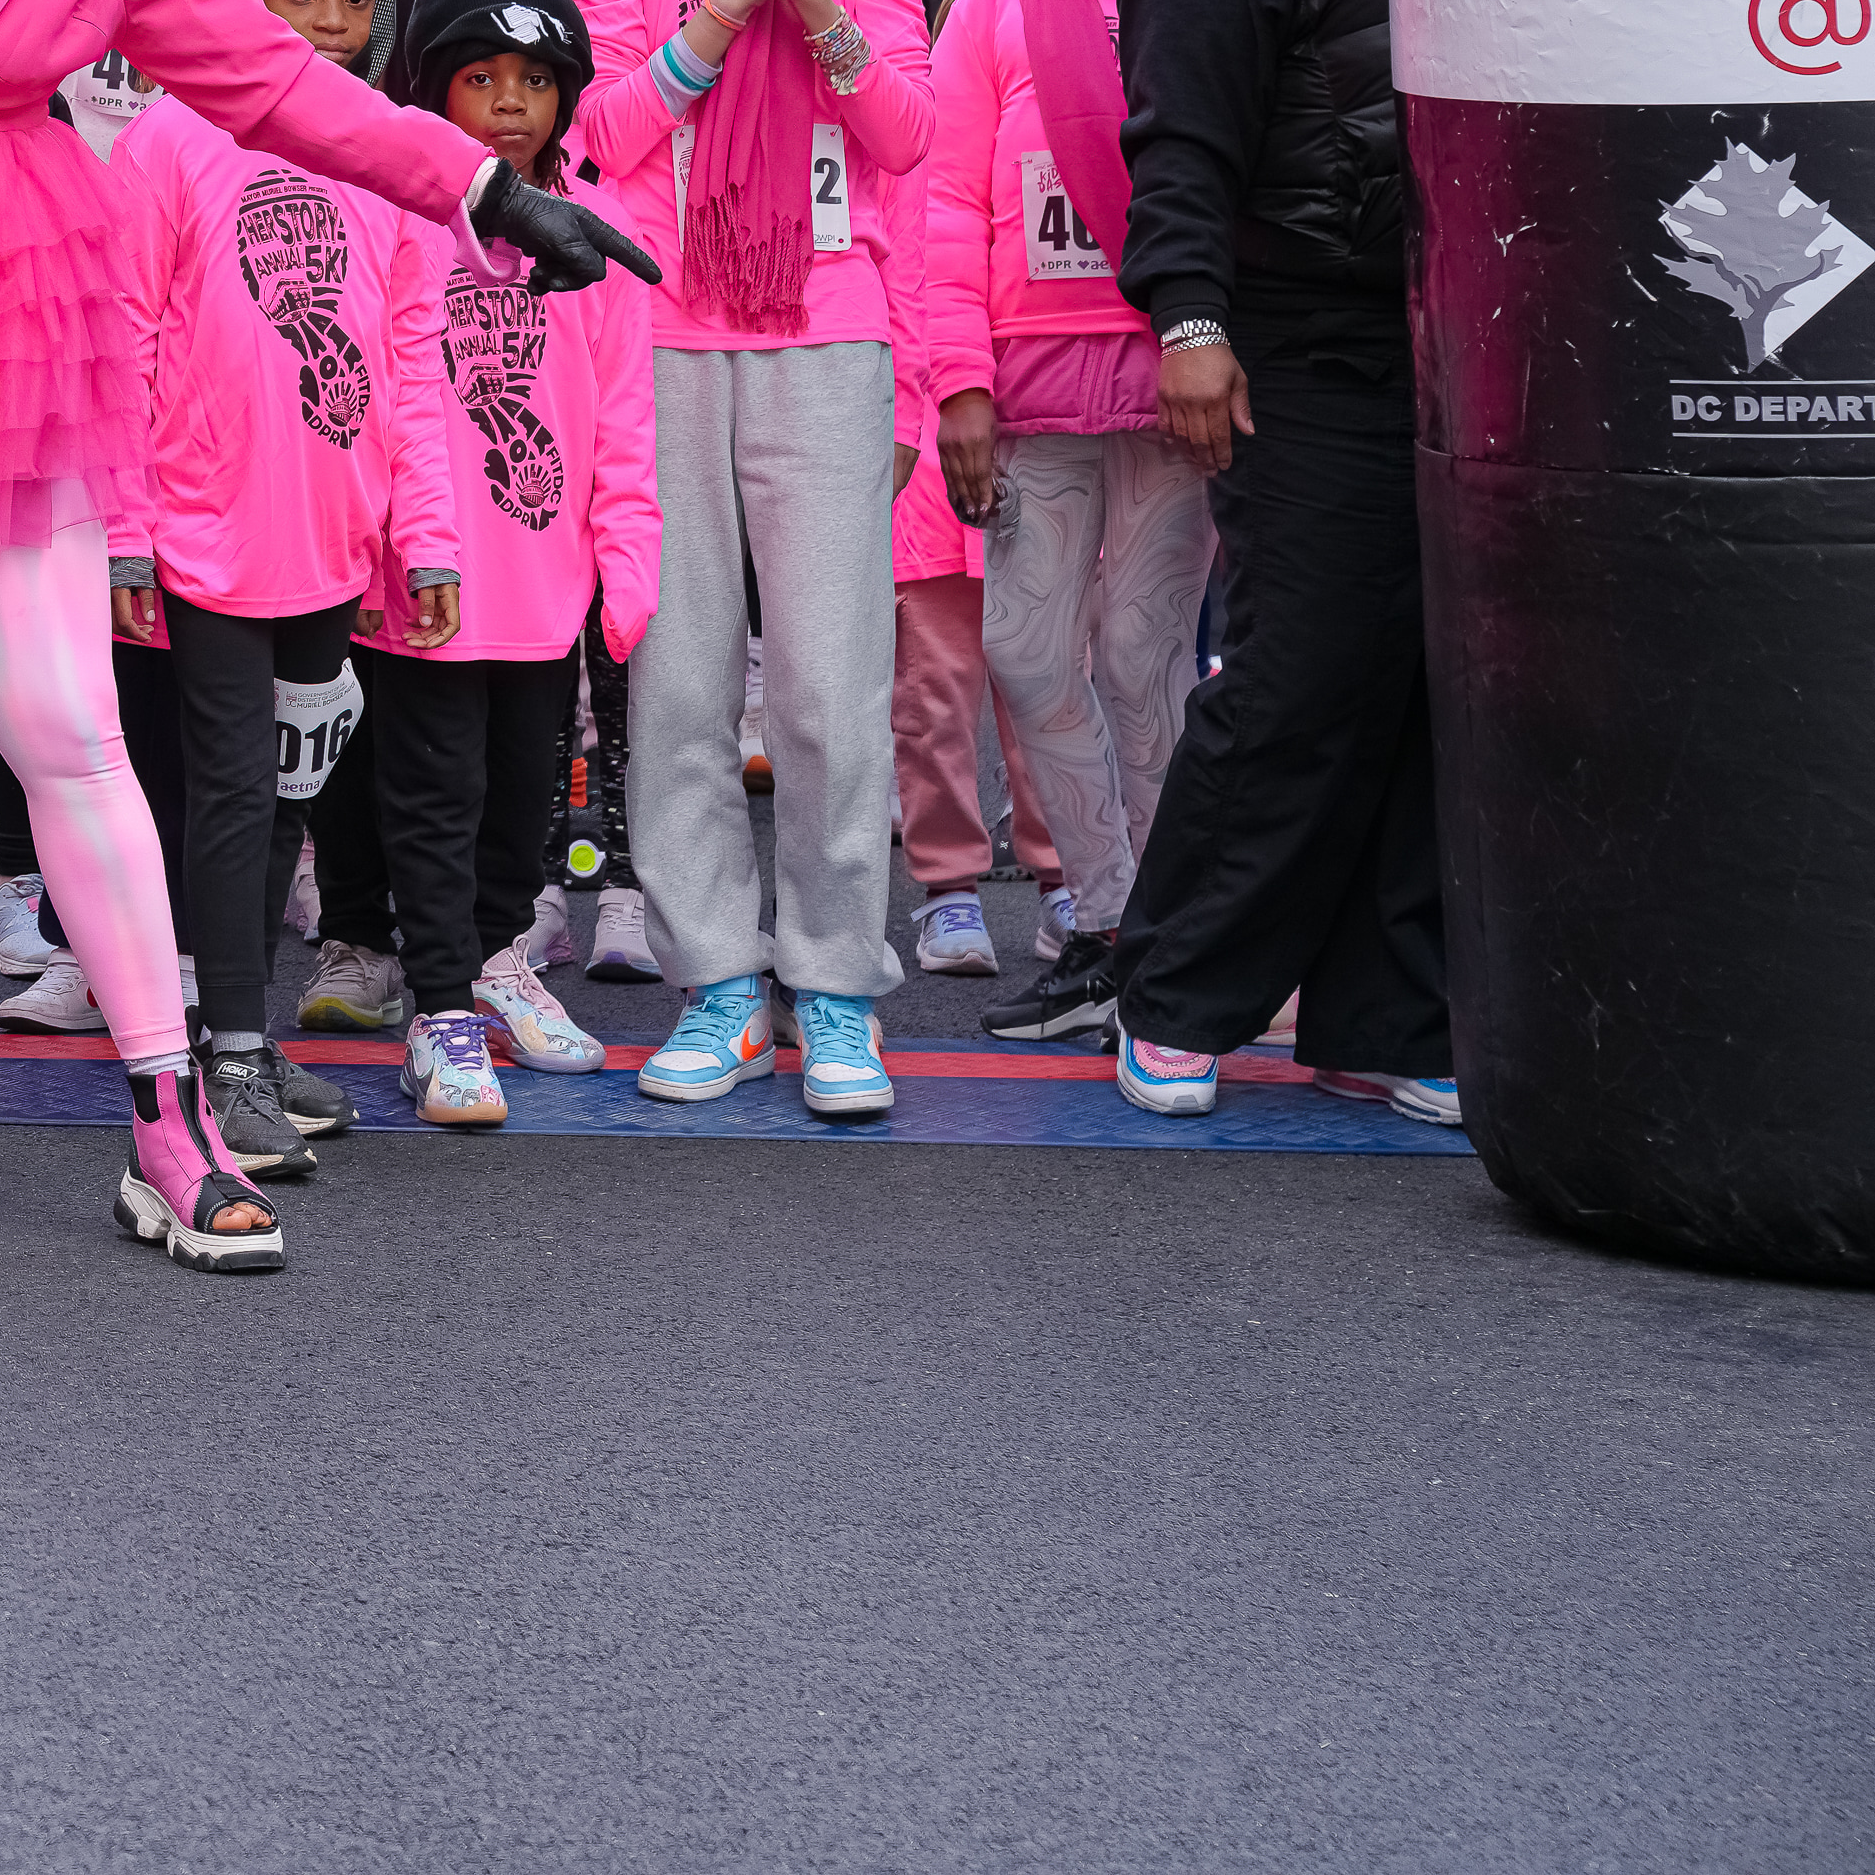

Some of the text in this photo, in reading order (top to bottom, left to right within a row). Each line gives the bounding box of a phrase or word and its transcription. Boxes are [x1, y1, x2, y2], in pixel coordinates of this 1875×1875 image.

[98, 97, 123, 108] DPR
[240, 192, 260, 203] MAYOR
[261, 188, 282, 198] MURIEL
[283, 185, 307, 193] BOWSER
[242, 201, 338, 247] HERSTORY
[254, 245, 341, 283] ANNUAL 5K
[1048, 260, 1071, 270] DPR
[445, 277, 464, 286] MAYOR
[445, 288, 540, 332] HERSTORY
[454, 331, 539, 369] ANNUAL 5K
[354, 364, 370, 423] FITDC
[1671, 395, 1722, 421] DC
[307, 415, 340, 444] DPR
[546, 446, 564, 505] FITDC
[499, 496, 529, 526] DPR
[280, 779, 320, 793] aetna
[221, 1064, 248, 1077] HOKA
